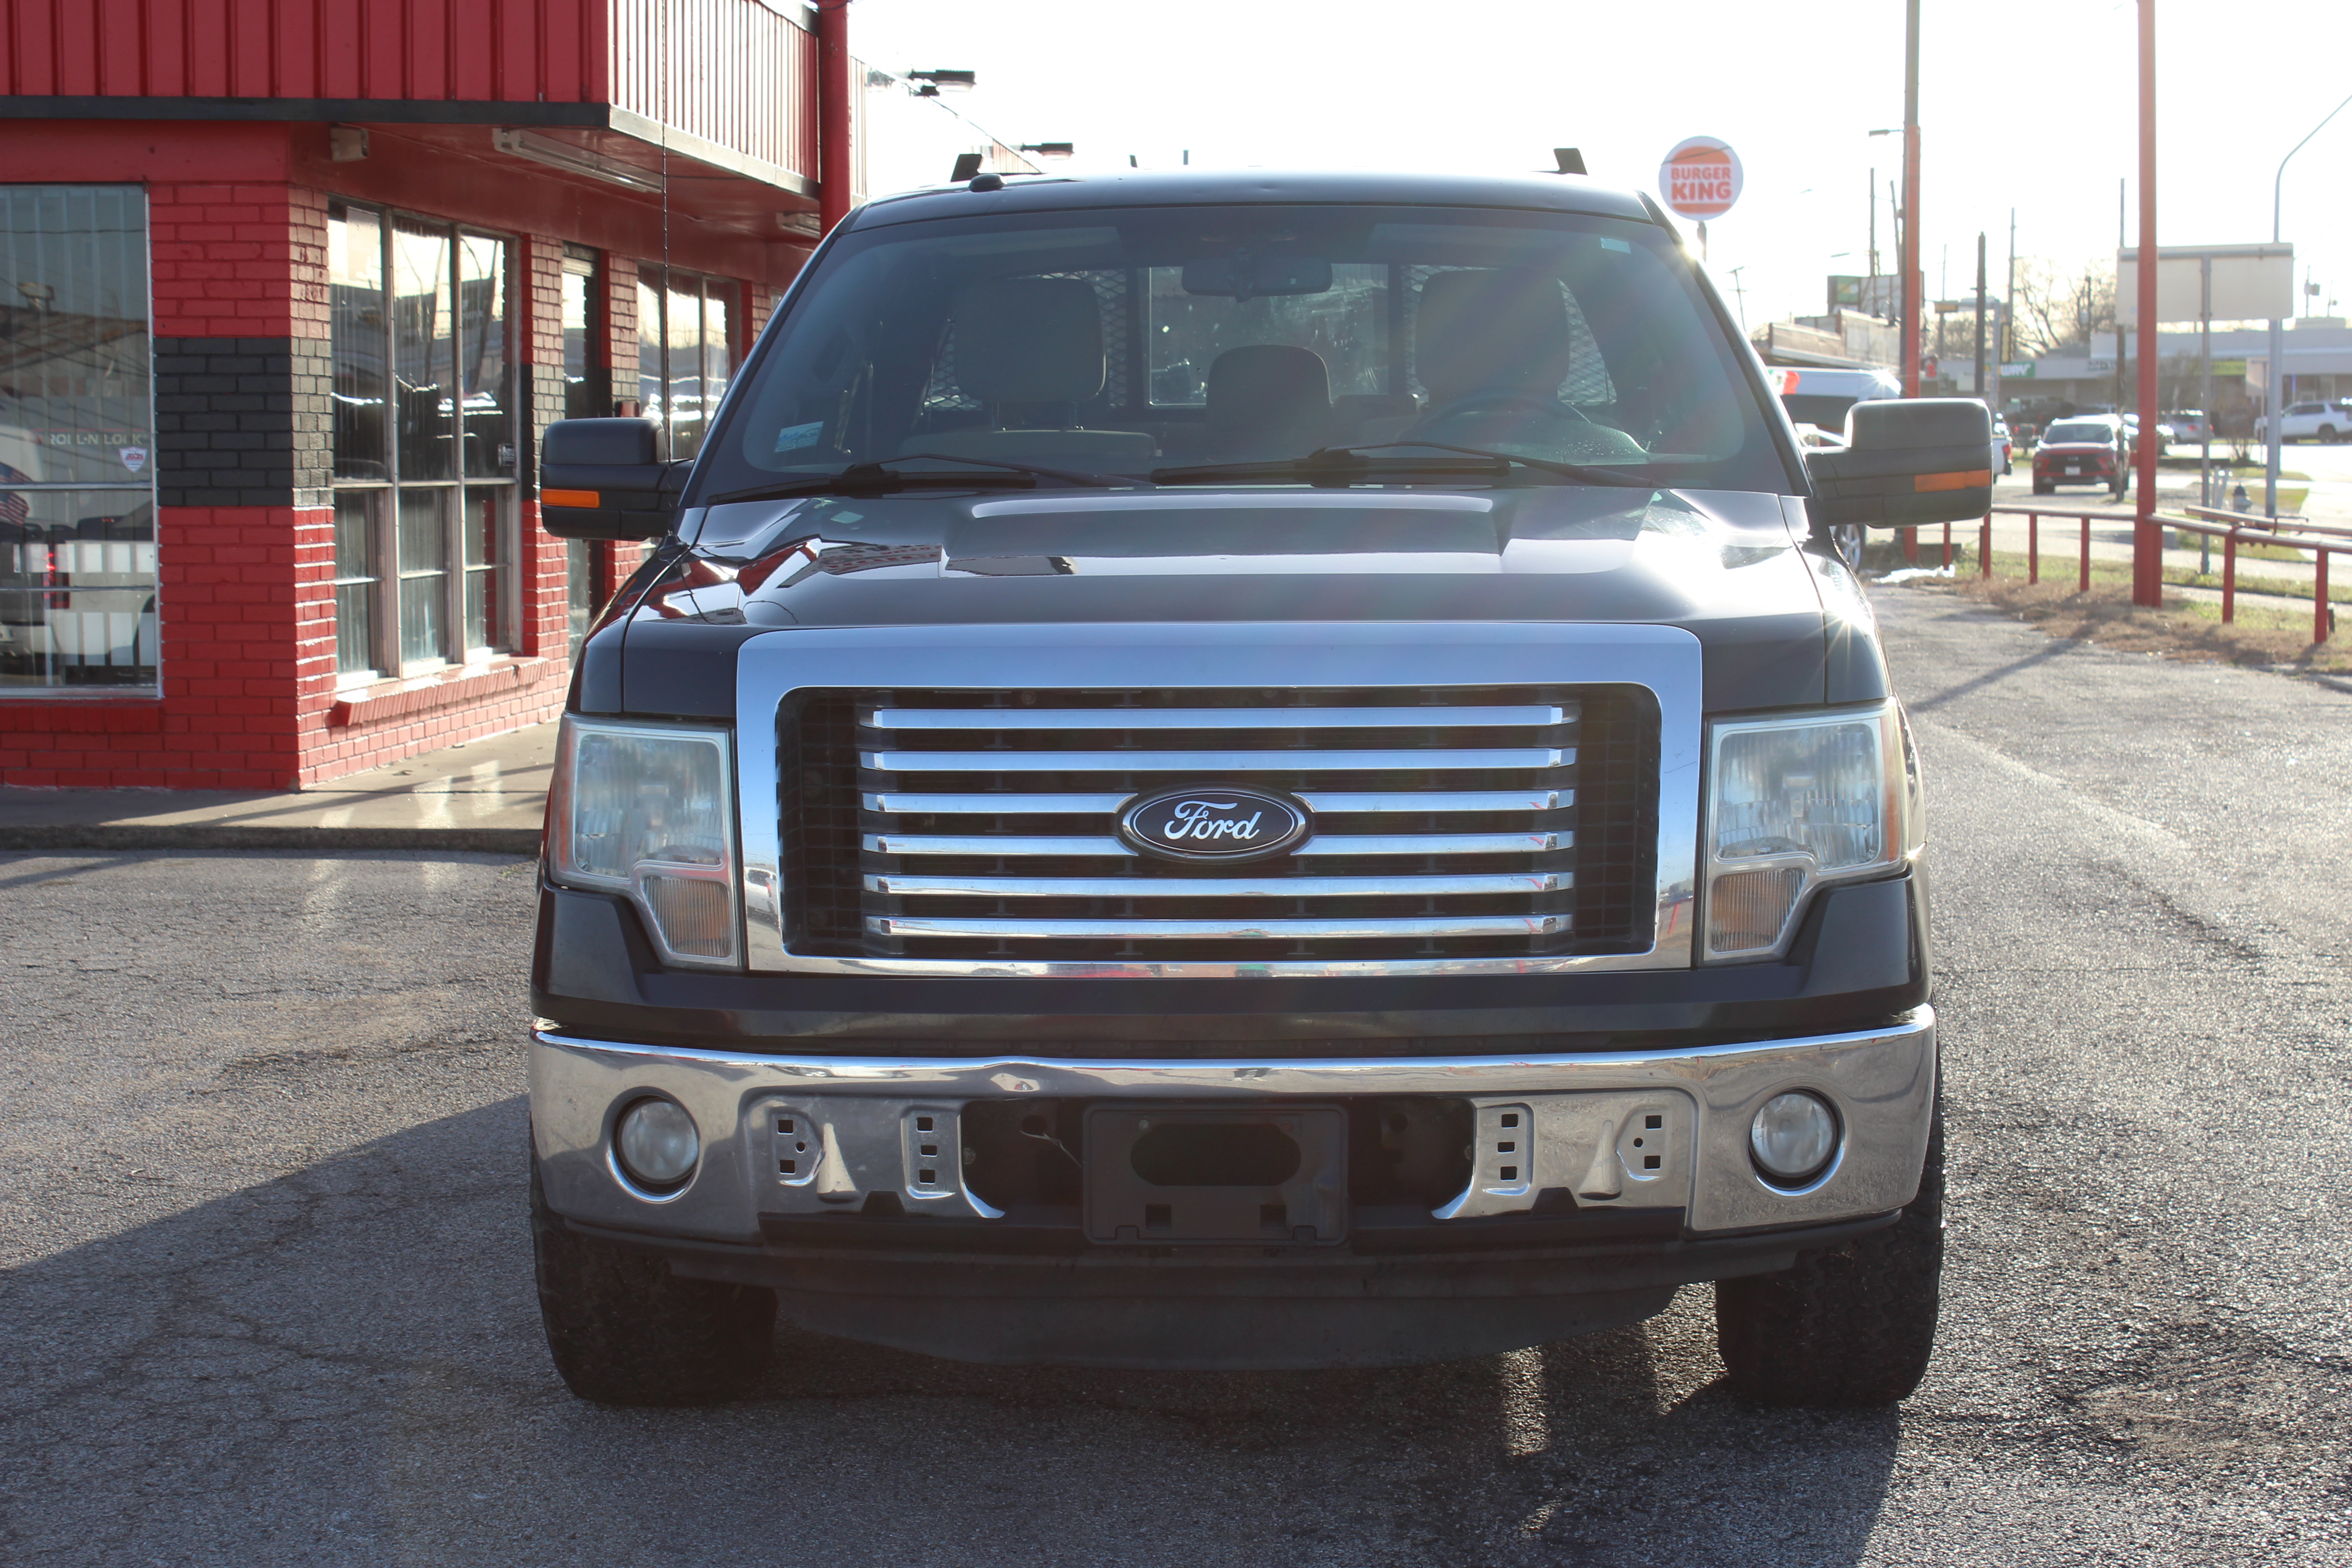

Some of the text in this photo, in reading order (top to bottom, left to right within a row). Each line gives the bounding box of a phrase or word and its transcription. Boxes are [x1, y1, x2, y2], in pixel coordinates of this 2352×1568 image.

[1671, 167, 1731, 180] BURGER
[1671, 182, 1732, 200] KING
[1164, 800, 1262, 840] Ford
